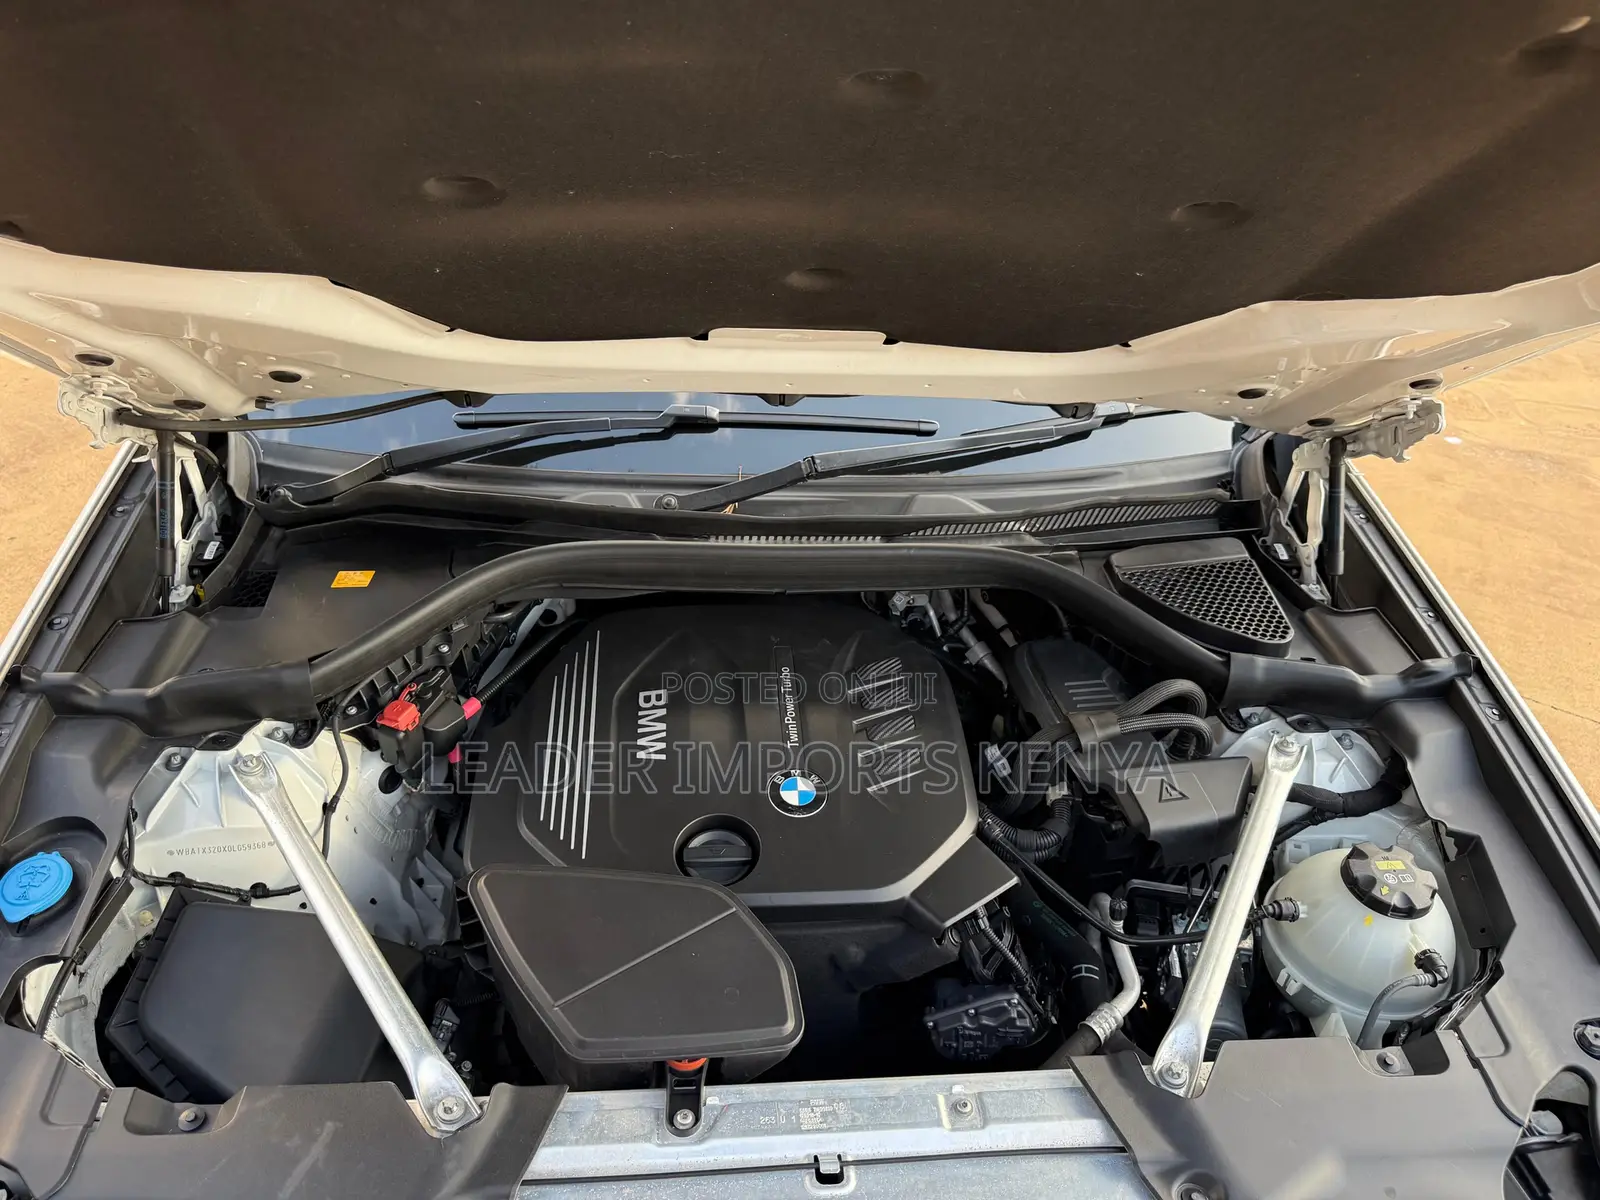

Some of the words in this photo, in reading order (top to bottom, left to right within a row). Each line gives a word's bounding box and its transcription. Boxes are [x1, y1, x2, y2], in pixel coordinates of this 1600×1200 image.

[779, 666, 793, 694] Turbo
[636, 688, 668, 760] BMW
[784, 694, 799, 748] TwinPower
[773, 769, 821, 785] BMW
